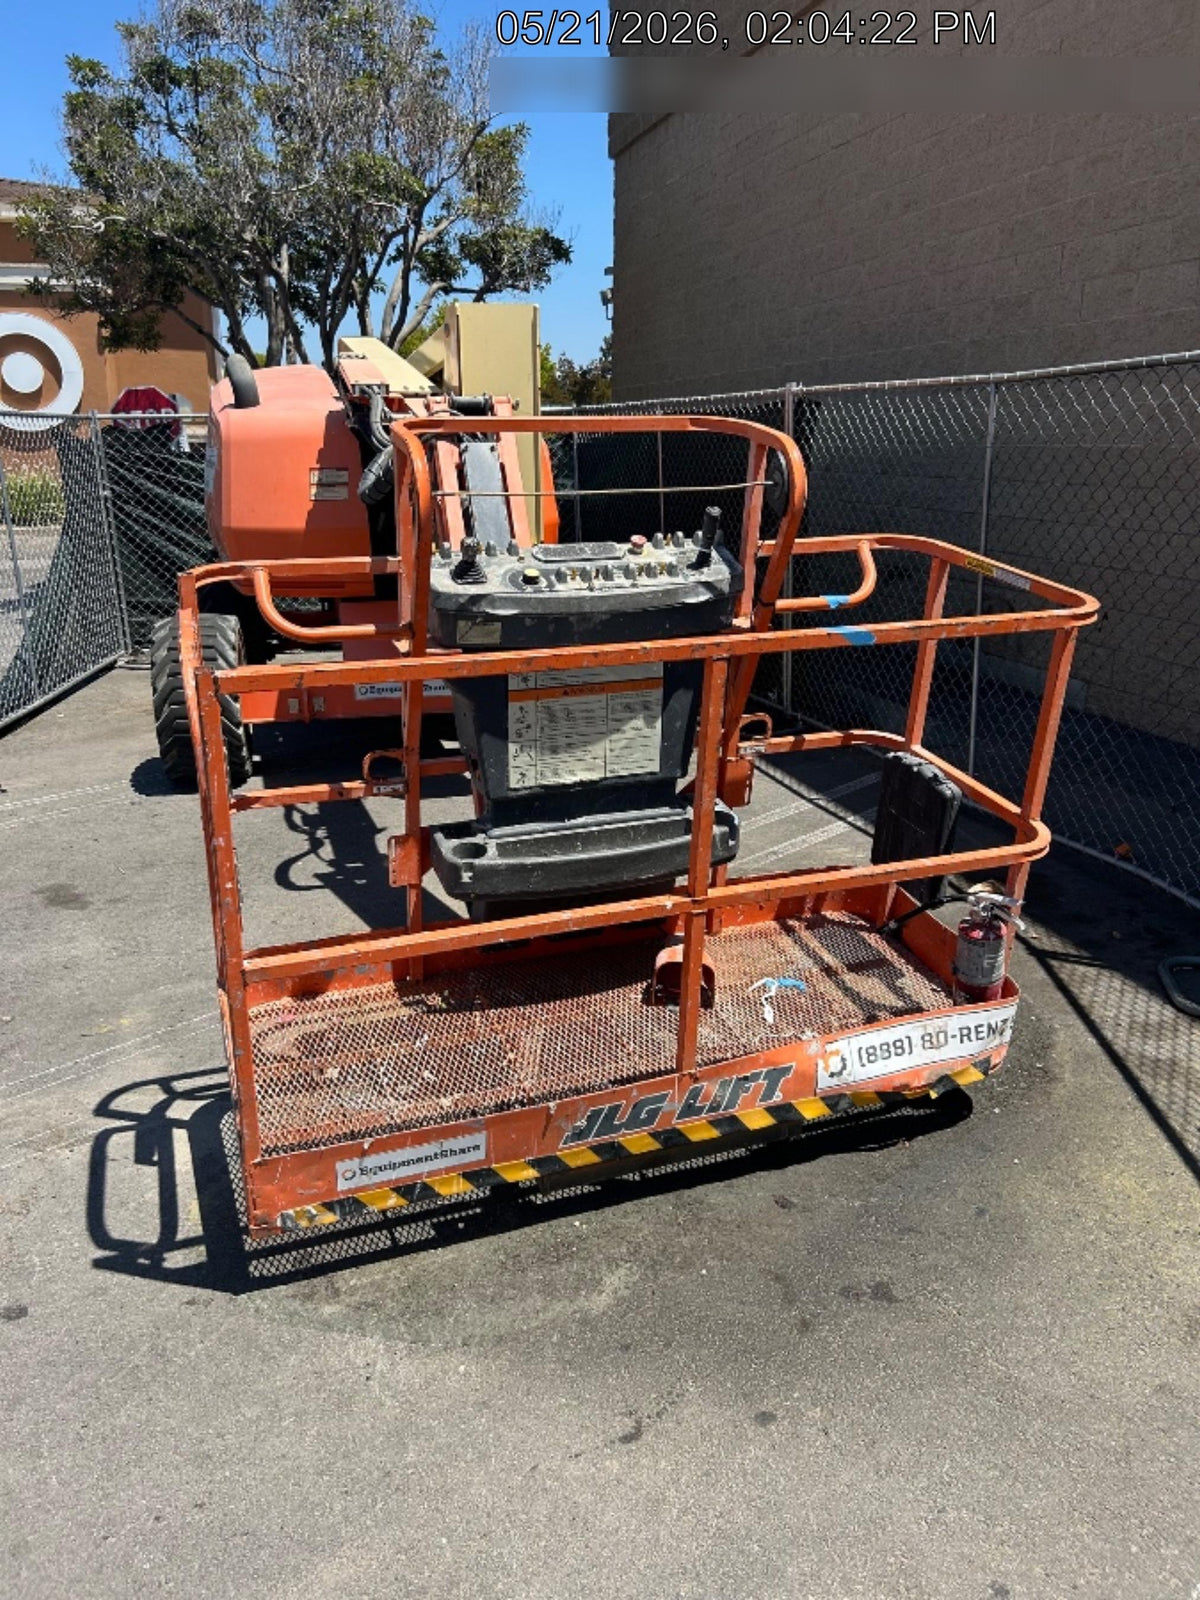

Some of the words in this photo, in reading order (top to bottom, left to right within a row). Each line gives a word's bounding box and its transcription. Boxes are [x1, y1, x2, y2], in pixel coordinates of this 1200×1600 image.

[858, 1036, 913, 1067] (888)
[560, 1090, 673, 1149] JLG
[673, 1062, 796, 1124] LIFT
[359, 1143, 481, 1175] EquipmentShare
